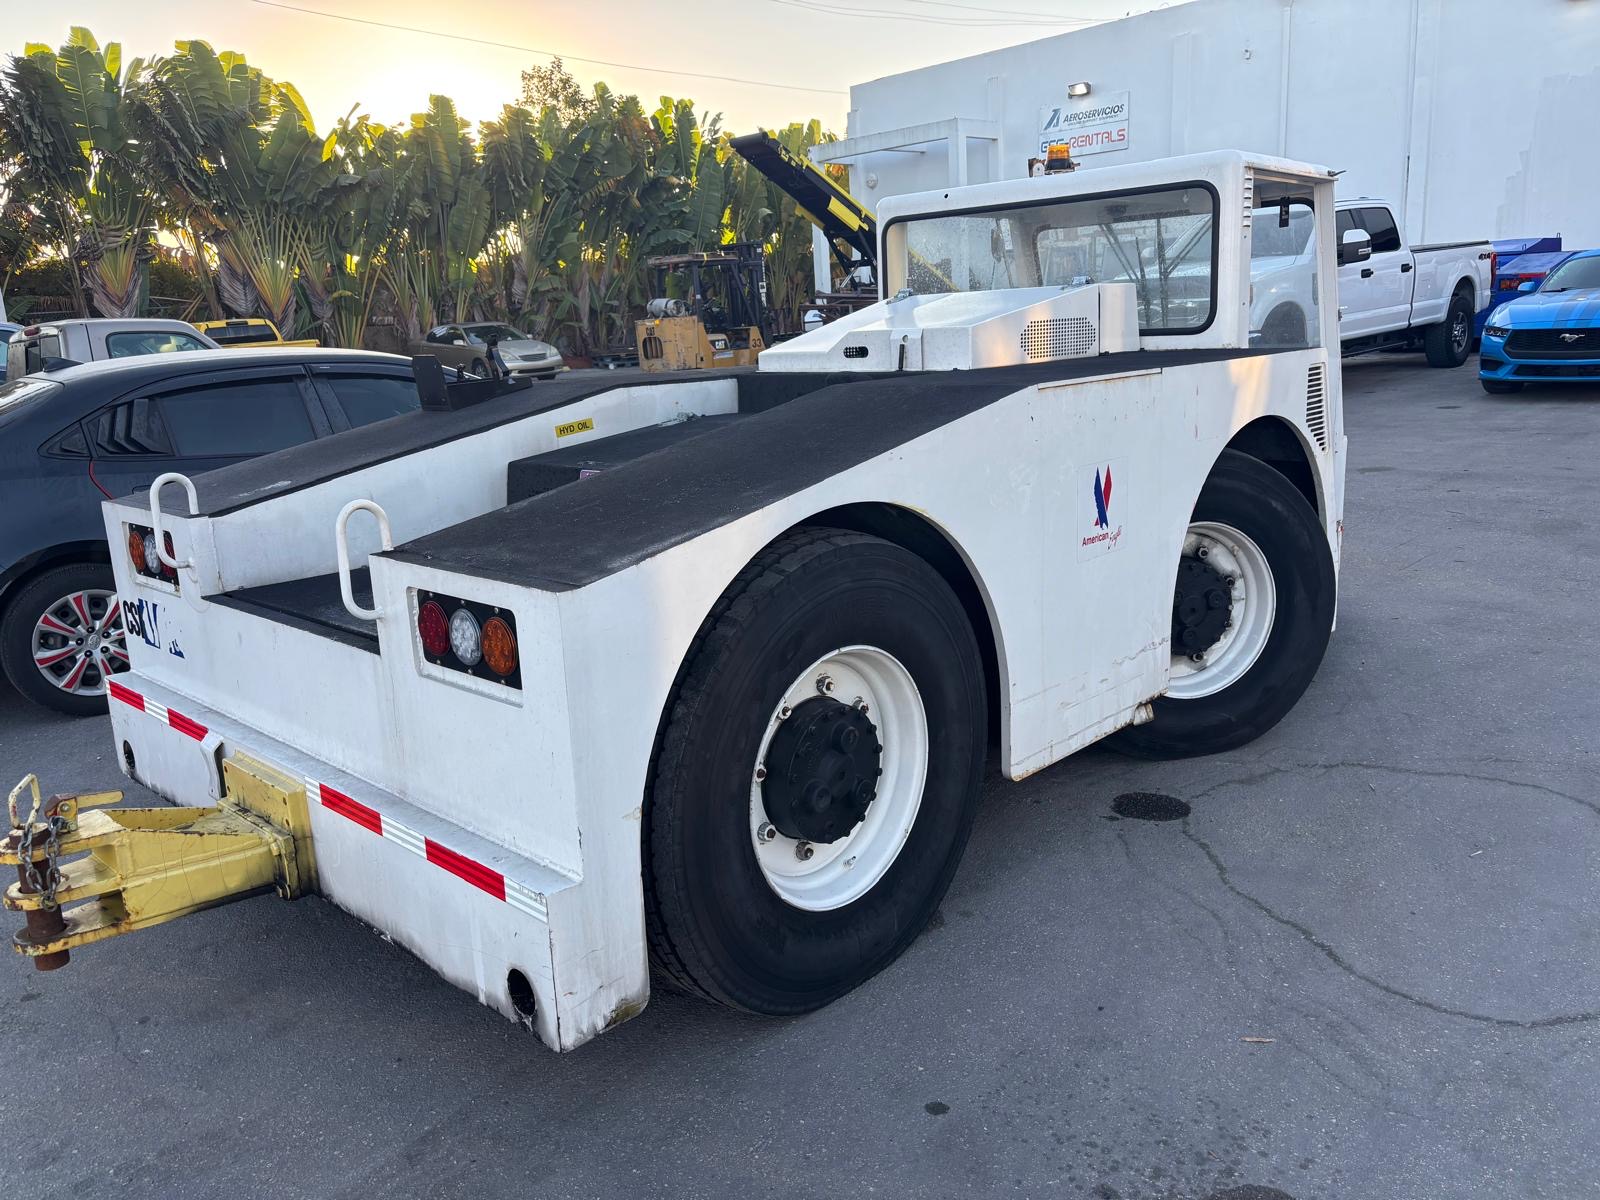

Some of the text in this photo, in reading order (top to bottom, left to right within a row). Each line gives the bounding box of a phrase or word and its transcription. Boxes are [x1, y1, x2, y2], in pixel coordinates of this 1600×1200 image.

[1063, 104, 1124, 123] AEROSERVICIOS
[752, 338, 761, 348] 33
[559, 421, 590, 435] HYD OIL
[1082, 532, 1109, 546] American
